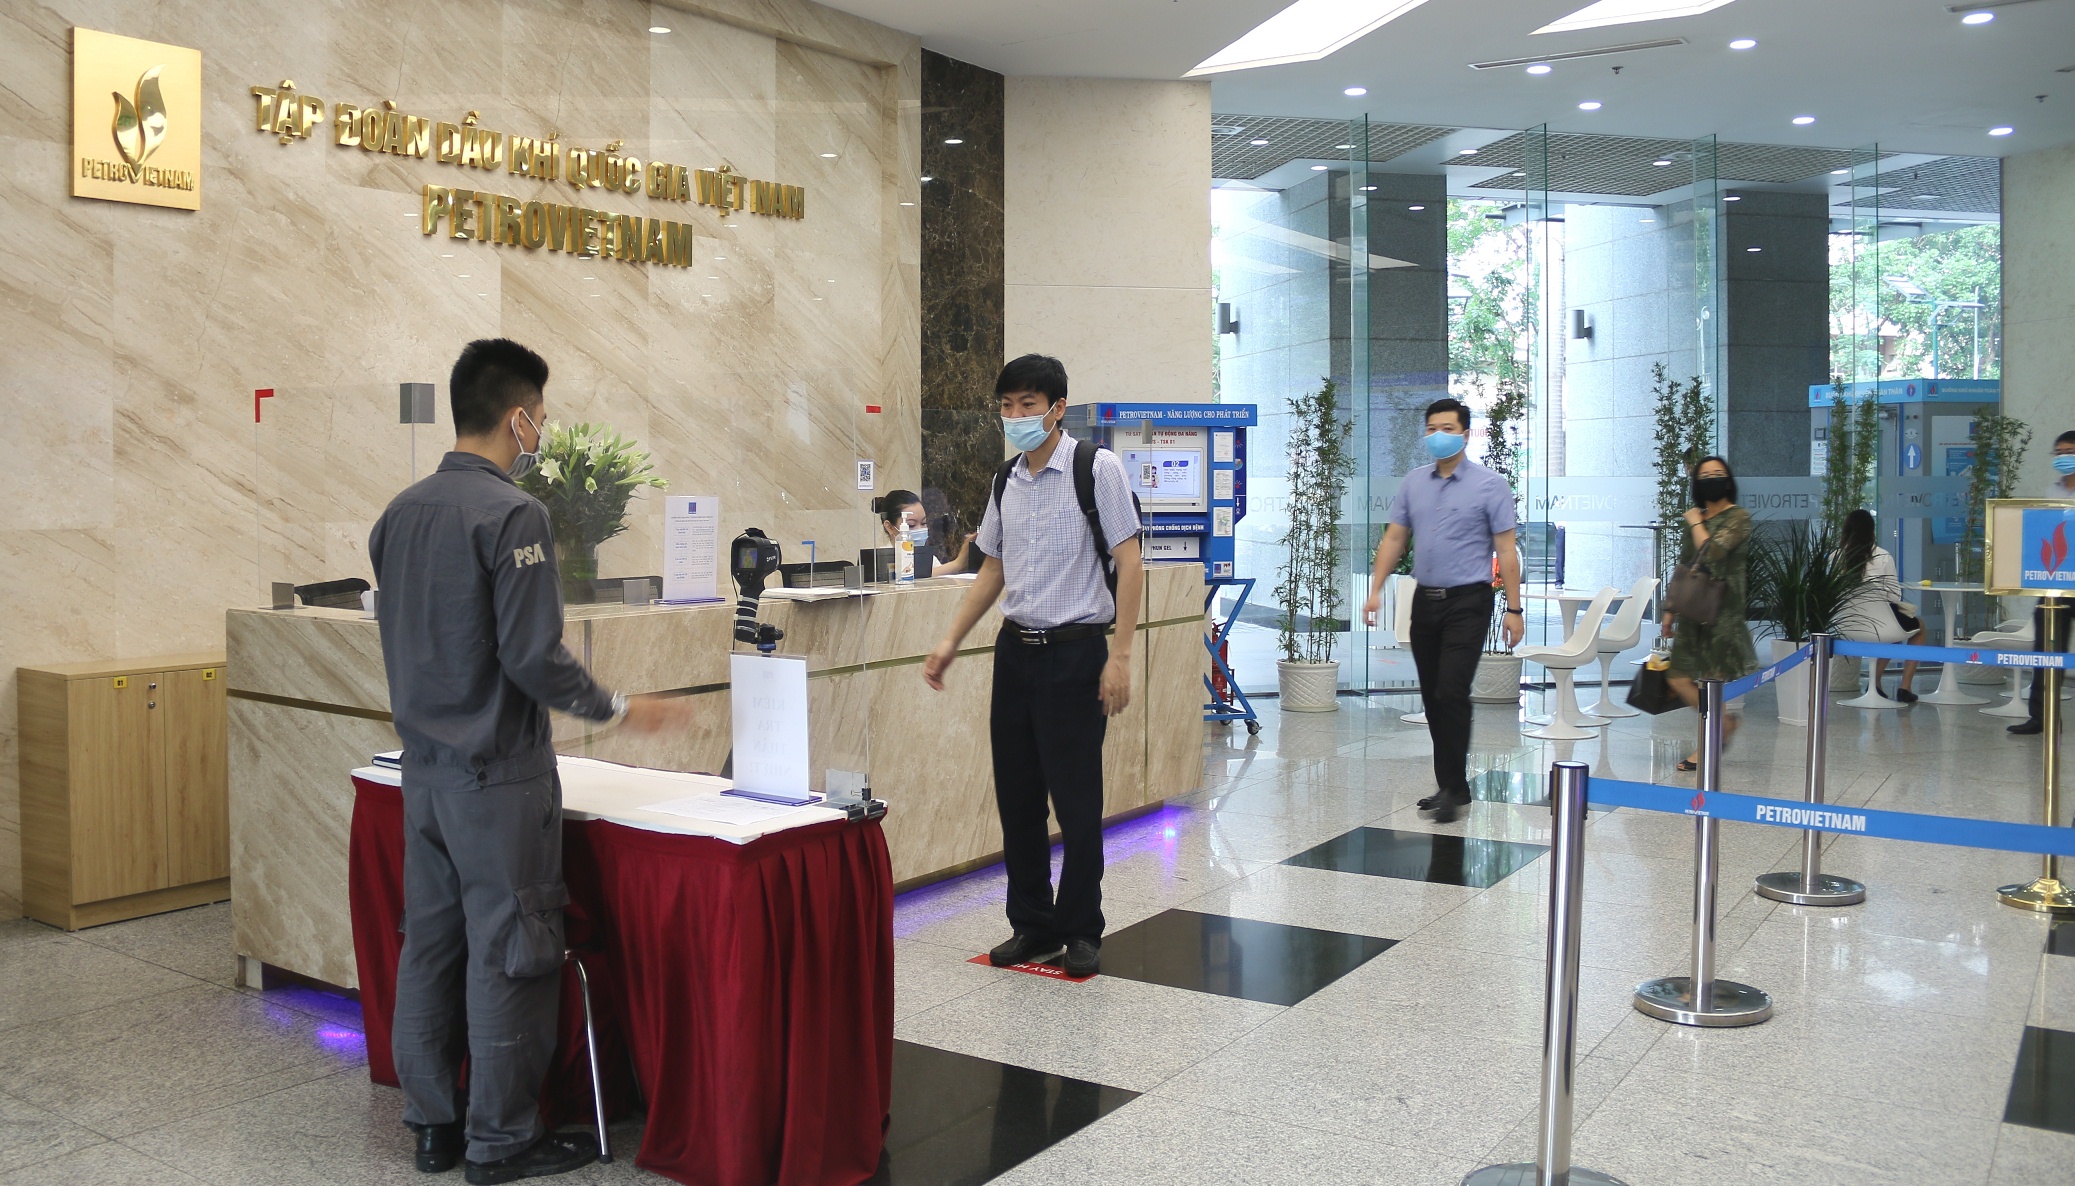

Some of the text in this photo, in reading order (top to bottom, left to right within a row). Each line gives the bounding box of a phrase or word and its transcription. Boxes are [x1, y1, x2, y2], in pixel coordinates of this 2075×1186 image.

[251, 79, 805, 220] TẬP ĐOÀN DẦU KHÍ QUỐC GIA VIỆT NAM
[82, 157, 194, 191] PETROVIETNAM
[423, 184, 693, 268] PETROVIETNAM
[1119, 410, 1163, 419] PETROVIETNAM
[1203, 410, 1215, 419] CHO
[1216, 409, 1231, 418] PHÁT
[513, 543, 546, 568] PSA
[1997, 653, 2064, 667] PETROVIETNAM
[1756, 804, 1866, 832] PETROVIETNAM
